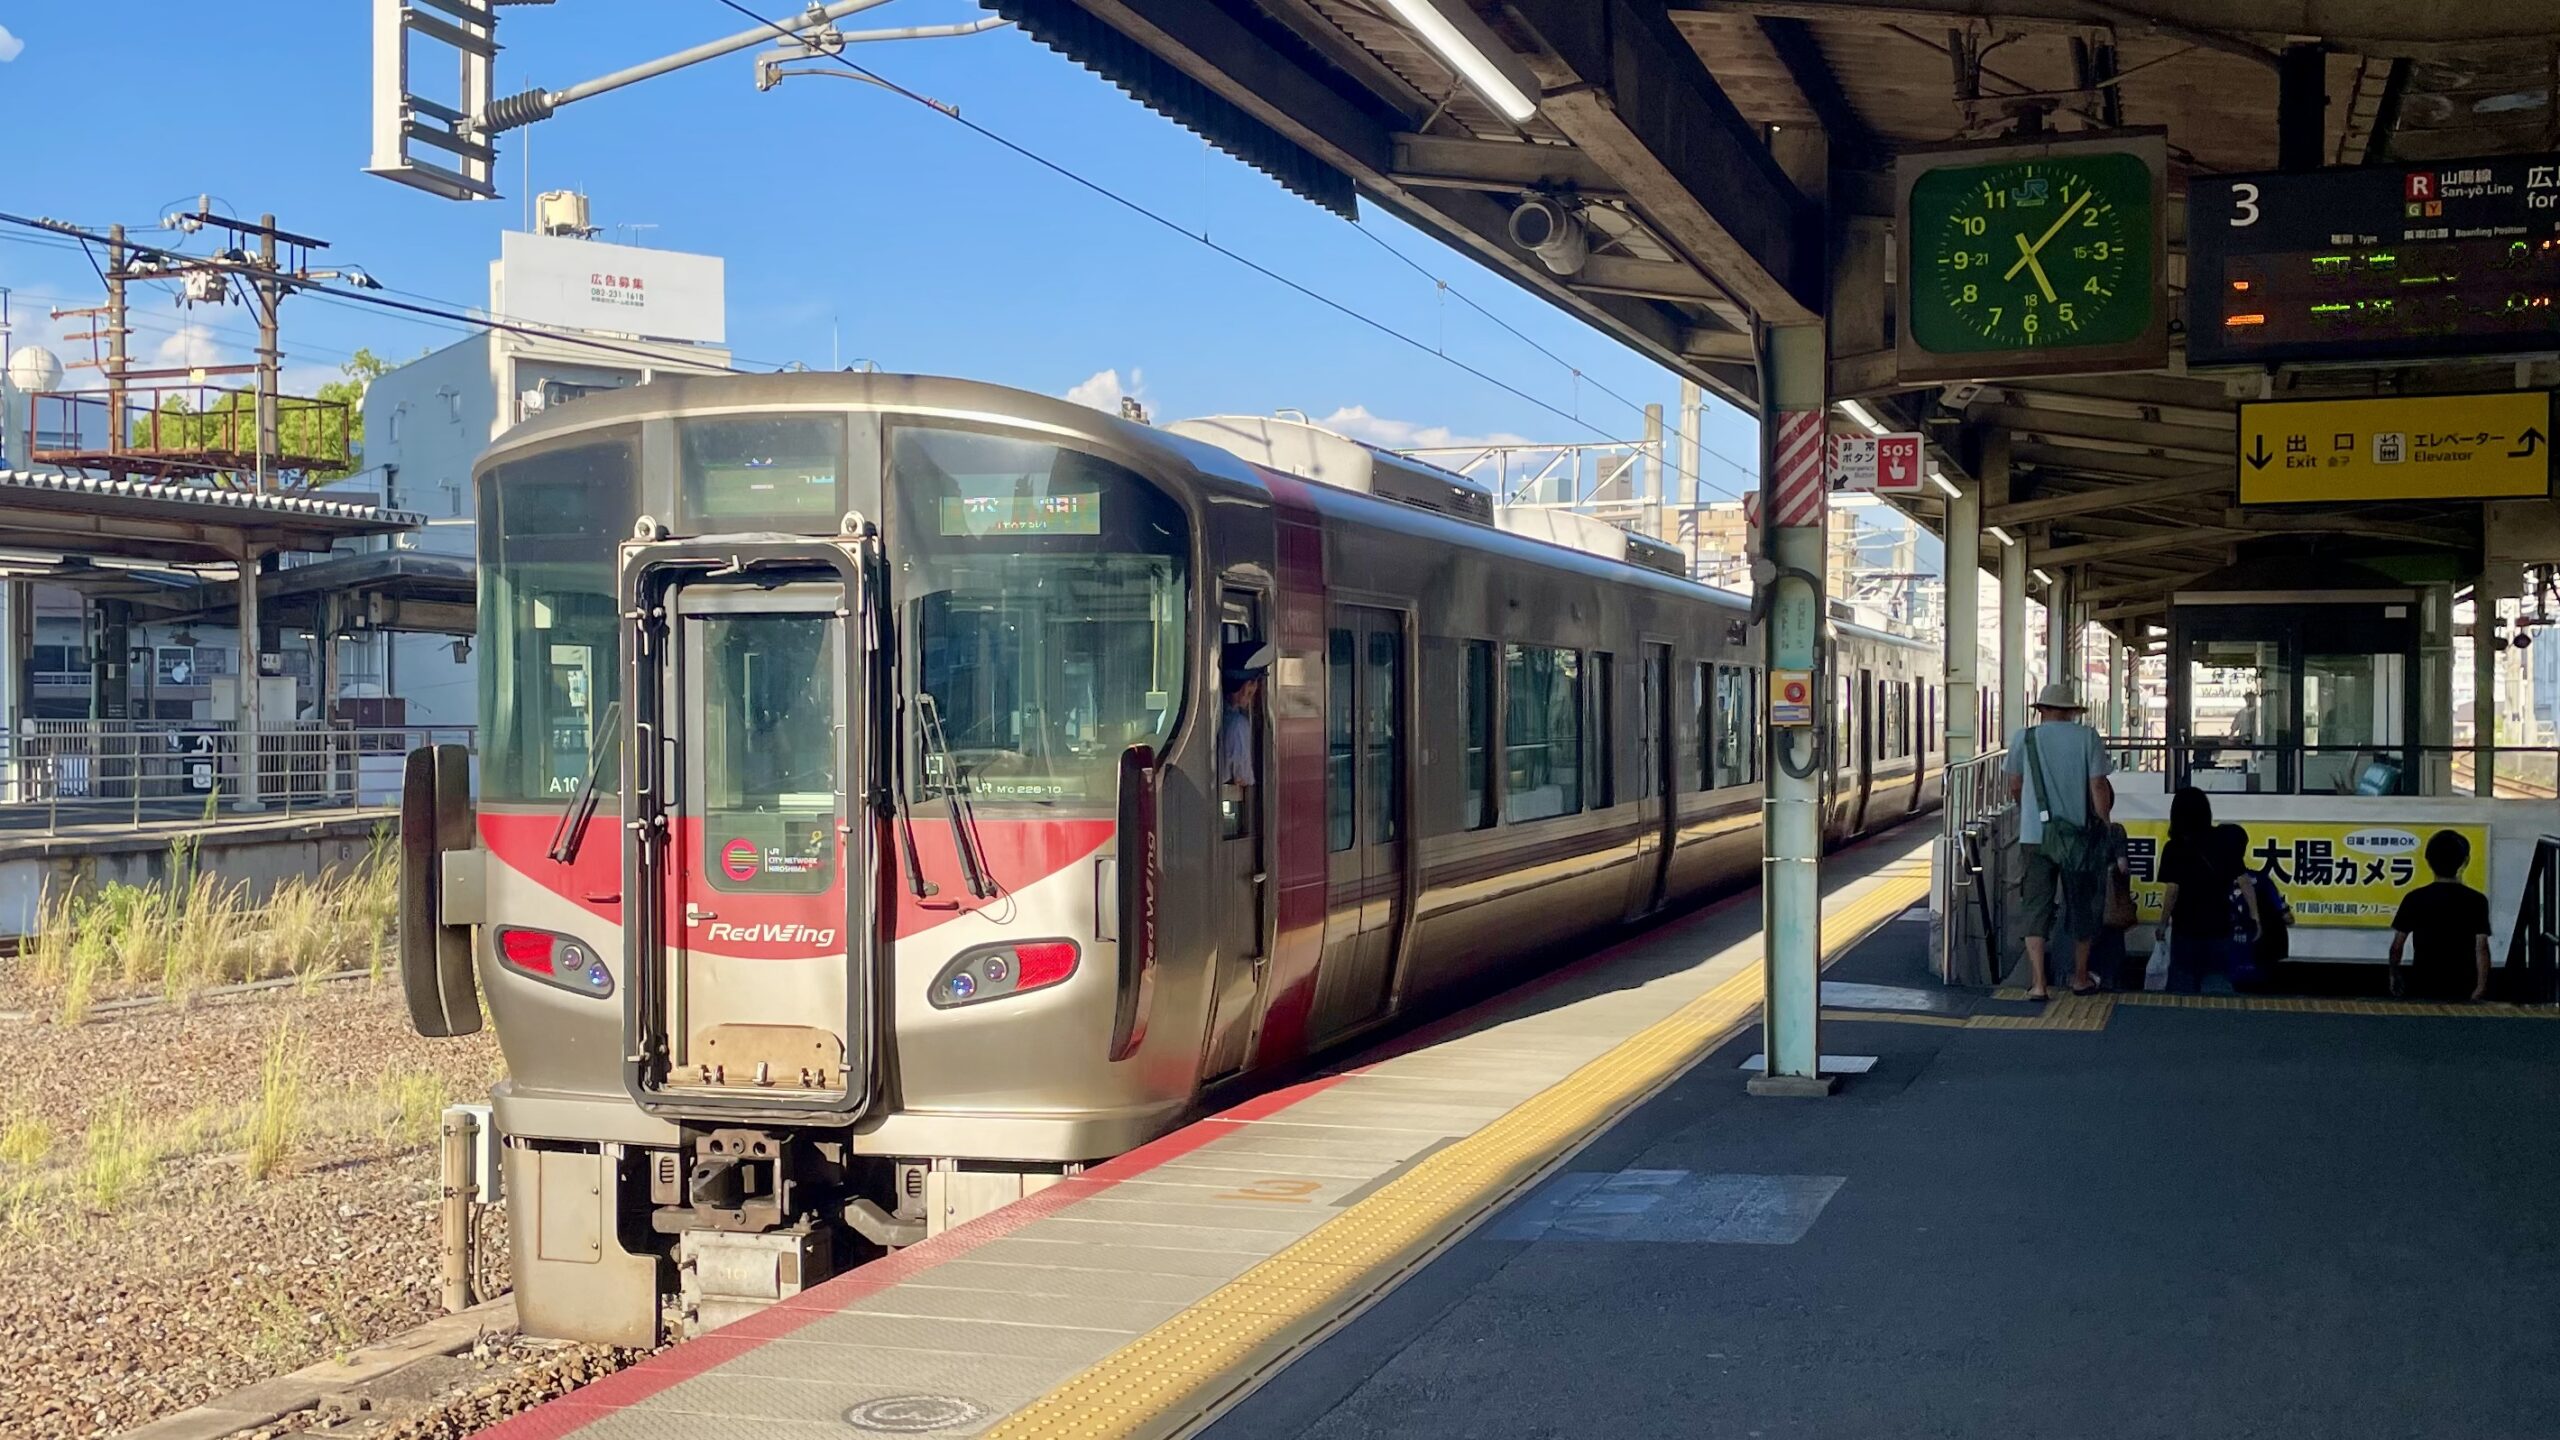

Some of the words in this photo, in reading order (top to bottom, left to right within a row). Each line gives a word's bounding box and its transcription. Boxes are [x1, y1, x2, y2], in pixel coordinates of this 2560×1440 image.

[2412, 176, 2429, 196] R
[2441, 169, 2492, 185] 山陽線
[2011, 178, 2049, 200] JR
[2060, 186, 2069, 203] 1
[2487, 183, 2514, 195] Line
[1984, 190, 2006, 209] 11
[2230, 183, 2259, 226] 3
[2527, 191, 2558, 209] for
[2083, 207, 2099, 227] 2
[2408, 204, 2420, 216] G
[1961, 216, 1986, 236] 10
[2494, 226, 2528, 235] Position
[591, 273, 644, 290] 広告募集
[2084, 276, 2100, 295] 4
[1963, 284, 1978, 302] 8
[1989, 307, 2003, 326] 7
[2059, 303, 2074, 321] 5
[2023, 314, 2038, 332] 6
[2286, 433, 2354, 453] 出口
[2414, 432, 2505, 448] エレベーター
[1842, 453, 1875, 463] ボタン
[1882, 444, 1914, 457] SOS
[2414, 451, 2474, 462] Elevator
[2286, 455, 2317, 469] Exit
[2253, 838, 2415, 886] 大腸カメラ
